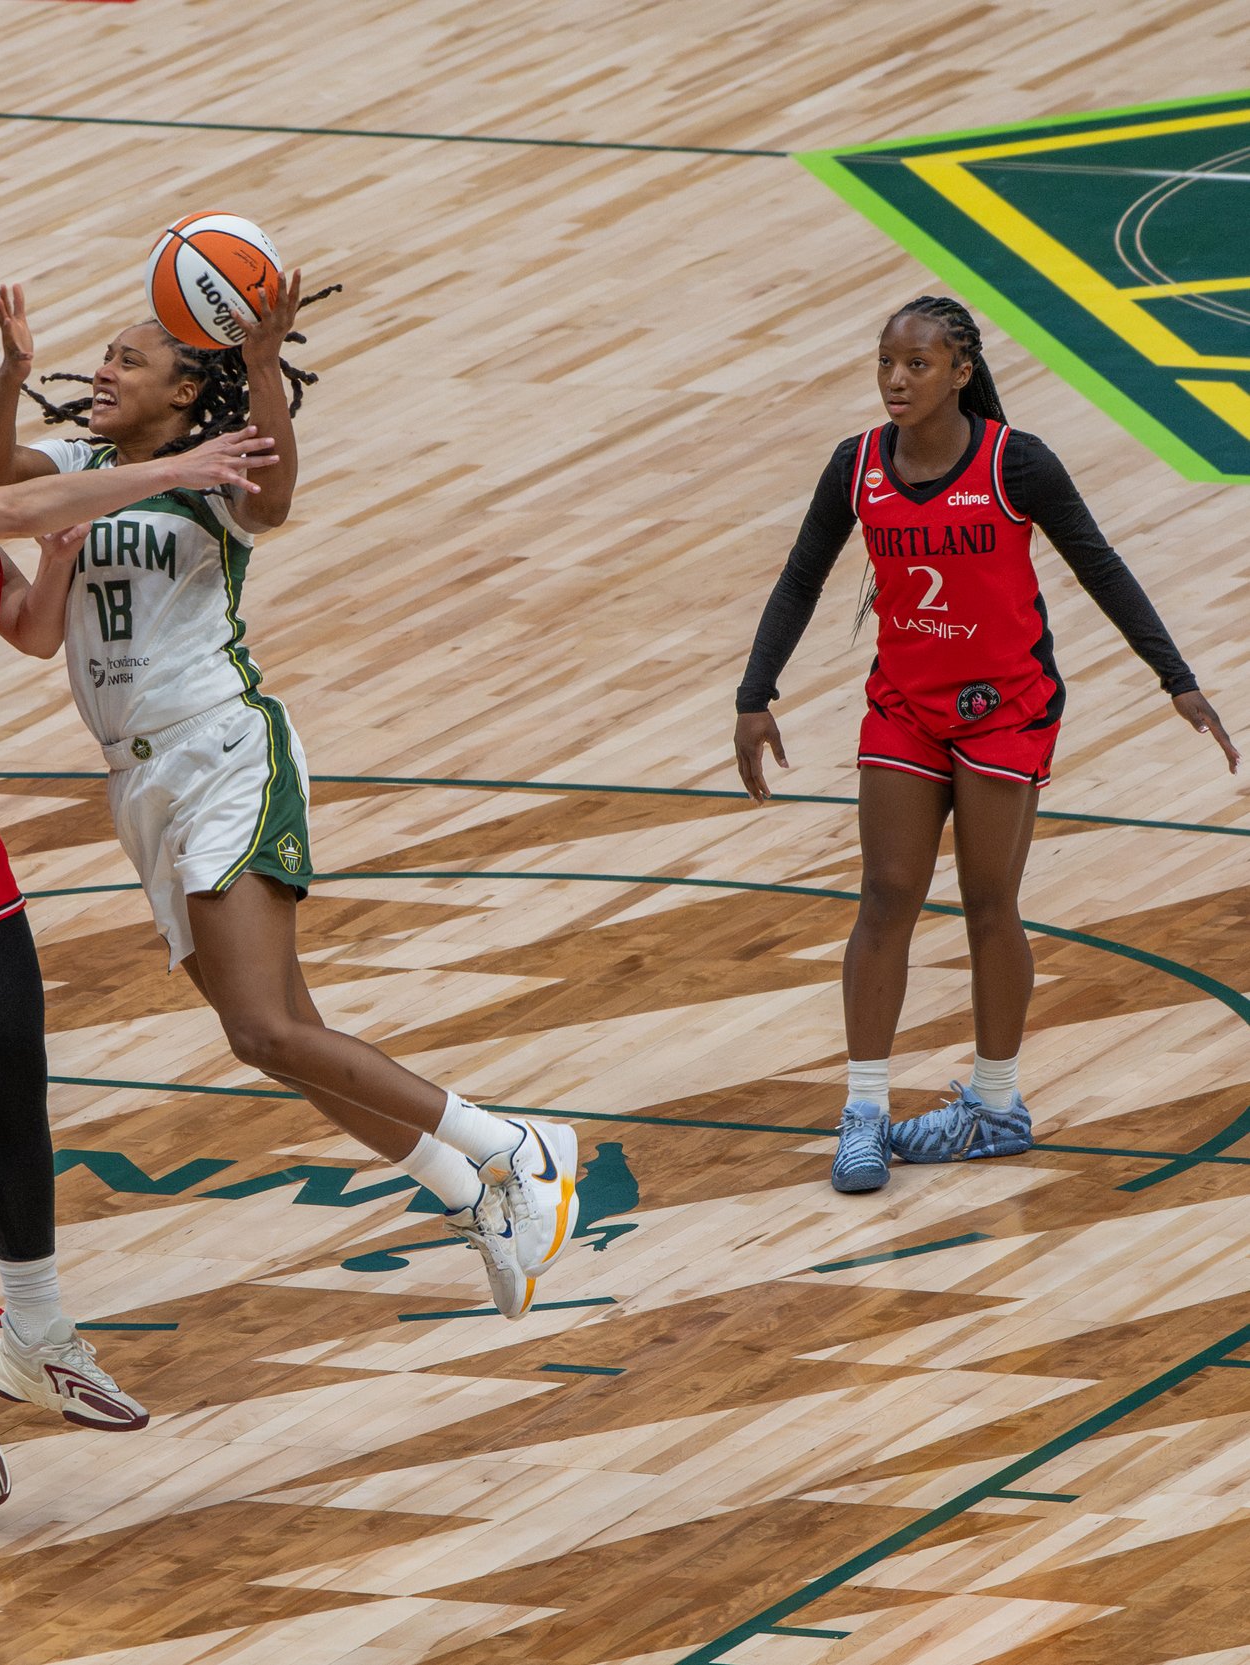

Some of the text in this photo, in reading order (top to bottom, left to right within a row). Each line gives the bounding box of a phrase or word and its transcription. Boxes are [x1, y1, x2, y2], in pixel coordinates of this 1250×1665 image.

[947, 491, 990, 506] chime
[77, 519, 176, 581] ORM
[865, 523, 997, 558] PORTLAND
[907, 565, 949, 612] 2
[893, 616, 978, 639] LASHIFY
